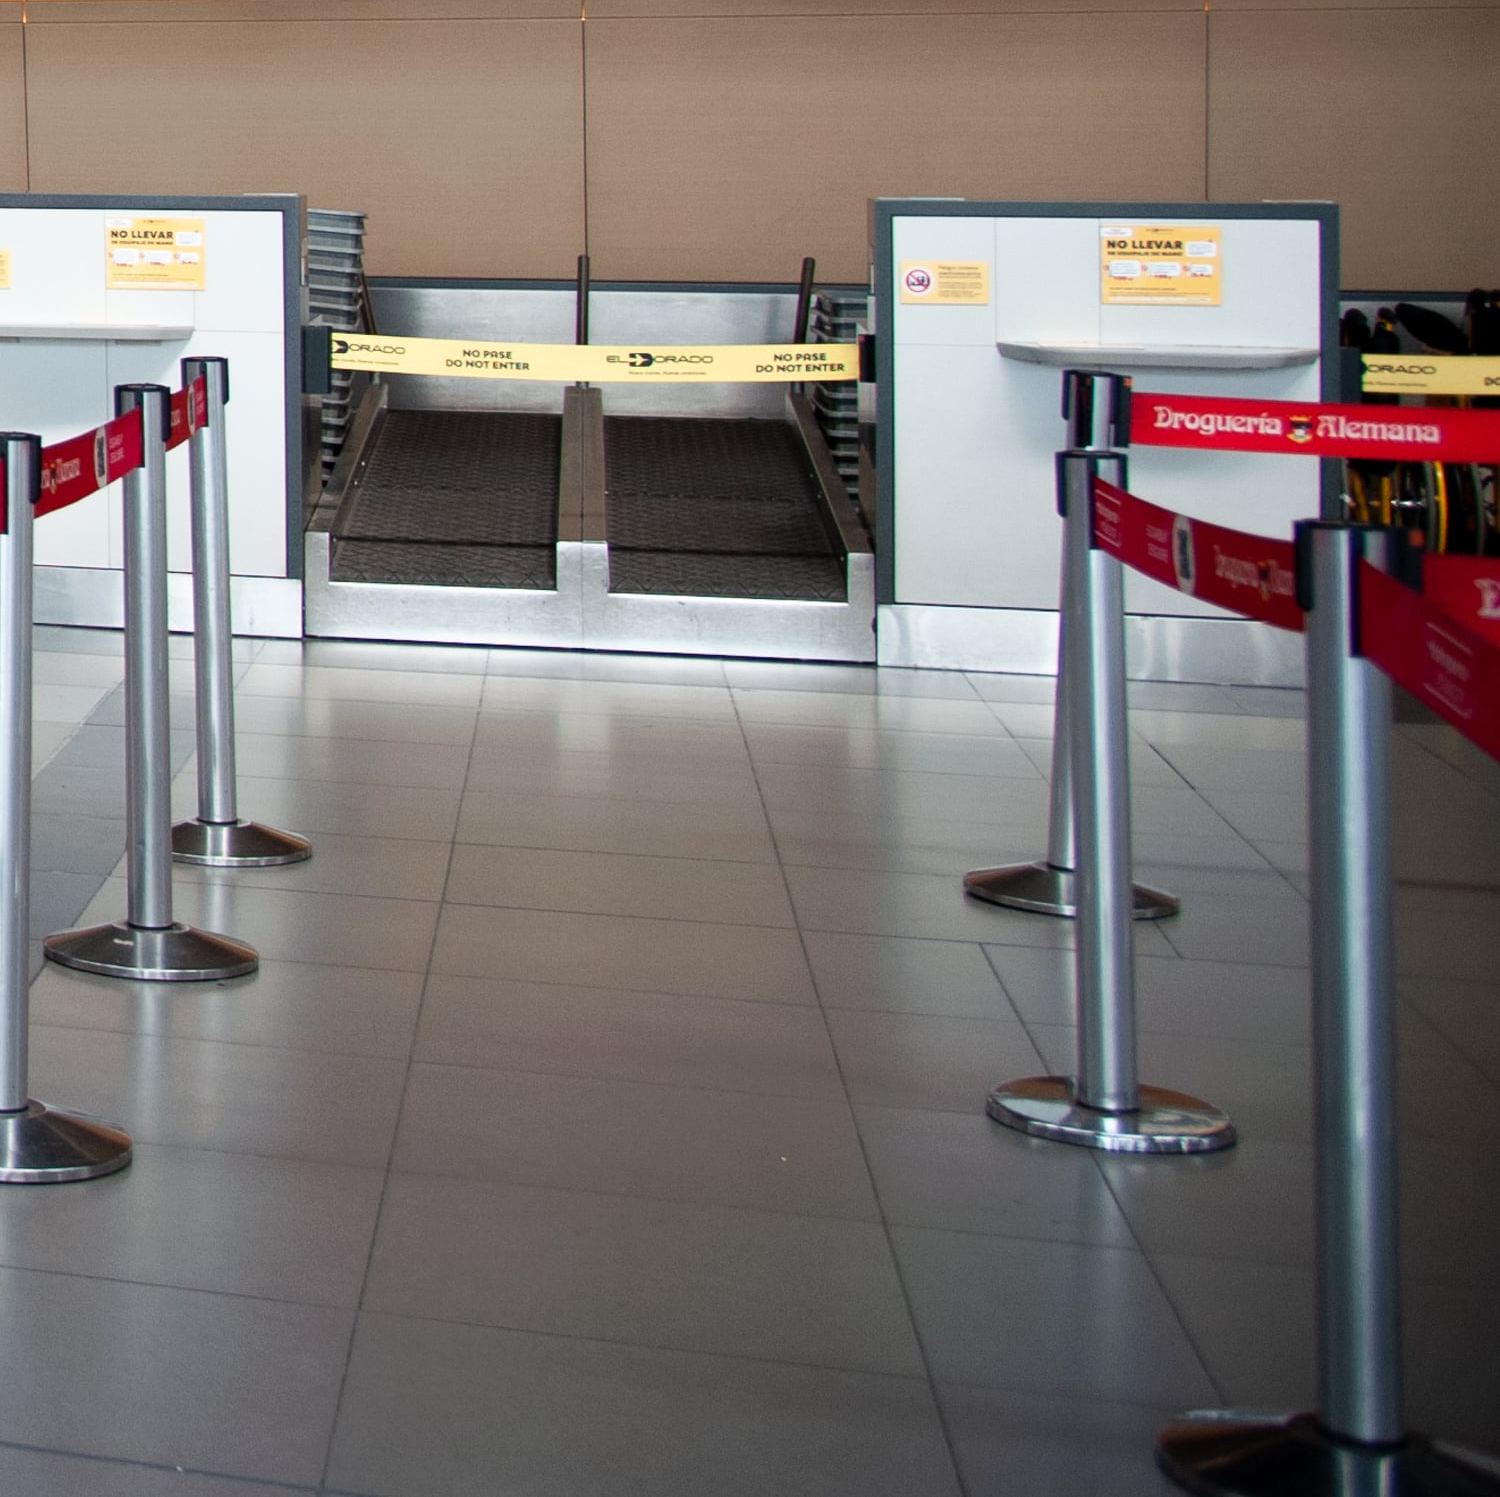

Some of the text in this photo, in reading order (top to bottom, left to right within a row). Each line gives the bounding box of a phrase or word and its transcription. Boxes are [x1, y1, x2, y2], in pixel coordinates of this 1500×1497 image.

[110, 231, 173, 239] NO LLEVAR
[1107, 240, 1183, 249] NO LLEVAR
[463, 349, 512, 359] NO PASE
[774, 353, 827, 362] NO PASE
[446, 359, 530, 370] DO NOT ENTER
[606, 353, 713, 367] EL DORADO
[777, 364, 802, 372] NOT
[805, 363, 845, 372] ENTER
[1153, 406, 1441, 443] Droguería Alemana
